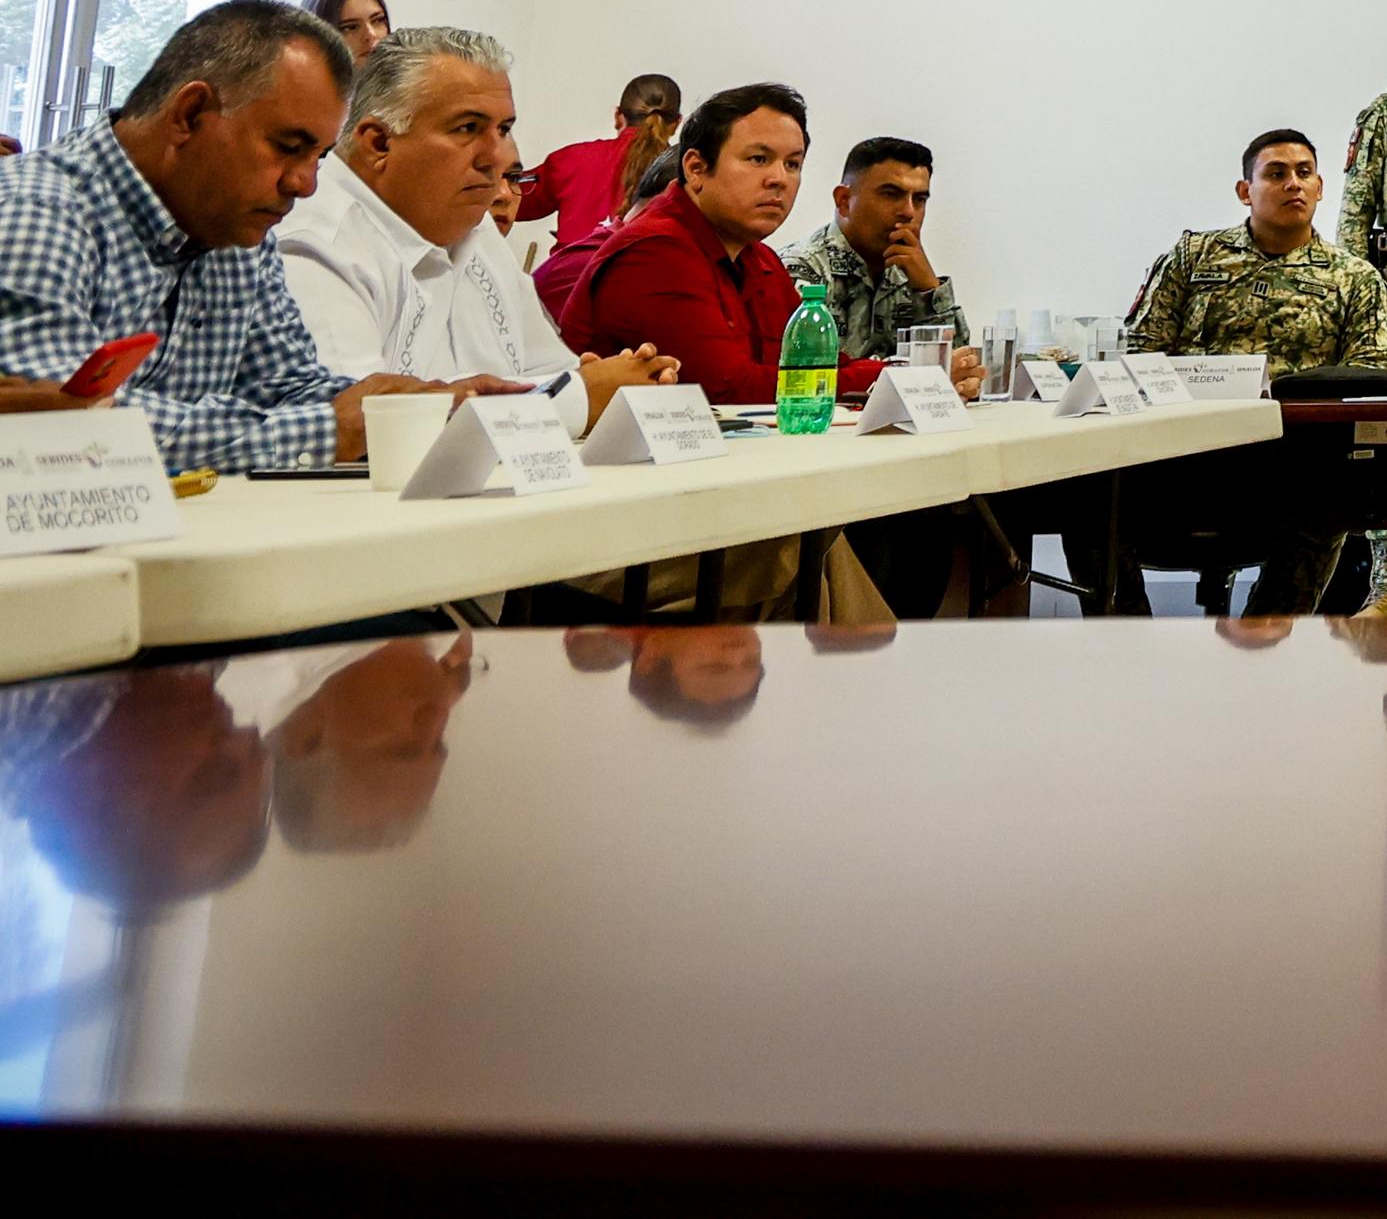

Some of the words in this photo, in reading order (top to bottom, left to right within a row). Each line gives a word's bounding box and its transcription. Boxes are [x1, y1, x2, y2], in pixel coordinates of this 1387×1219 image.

[1188, 374, 1226, 383] SEDENA
[6, 484, 151, 512] AYUNTAMIENTO
[6, 512, 34, 533] DE
[38, 505, 139, 531] MOCORITO
